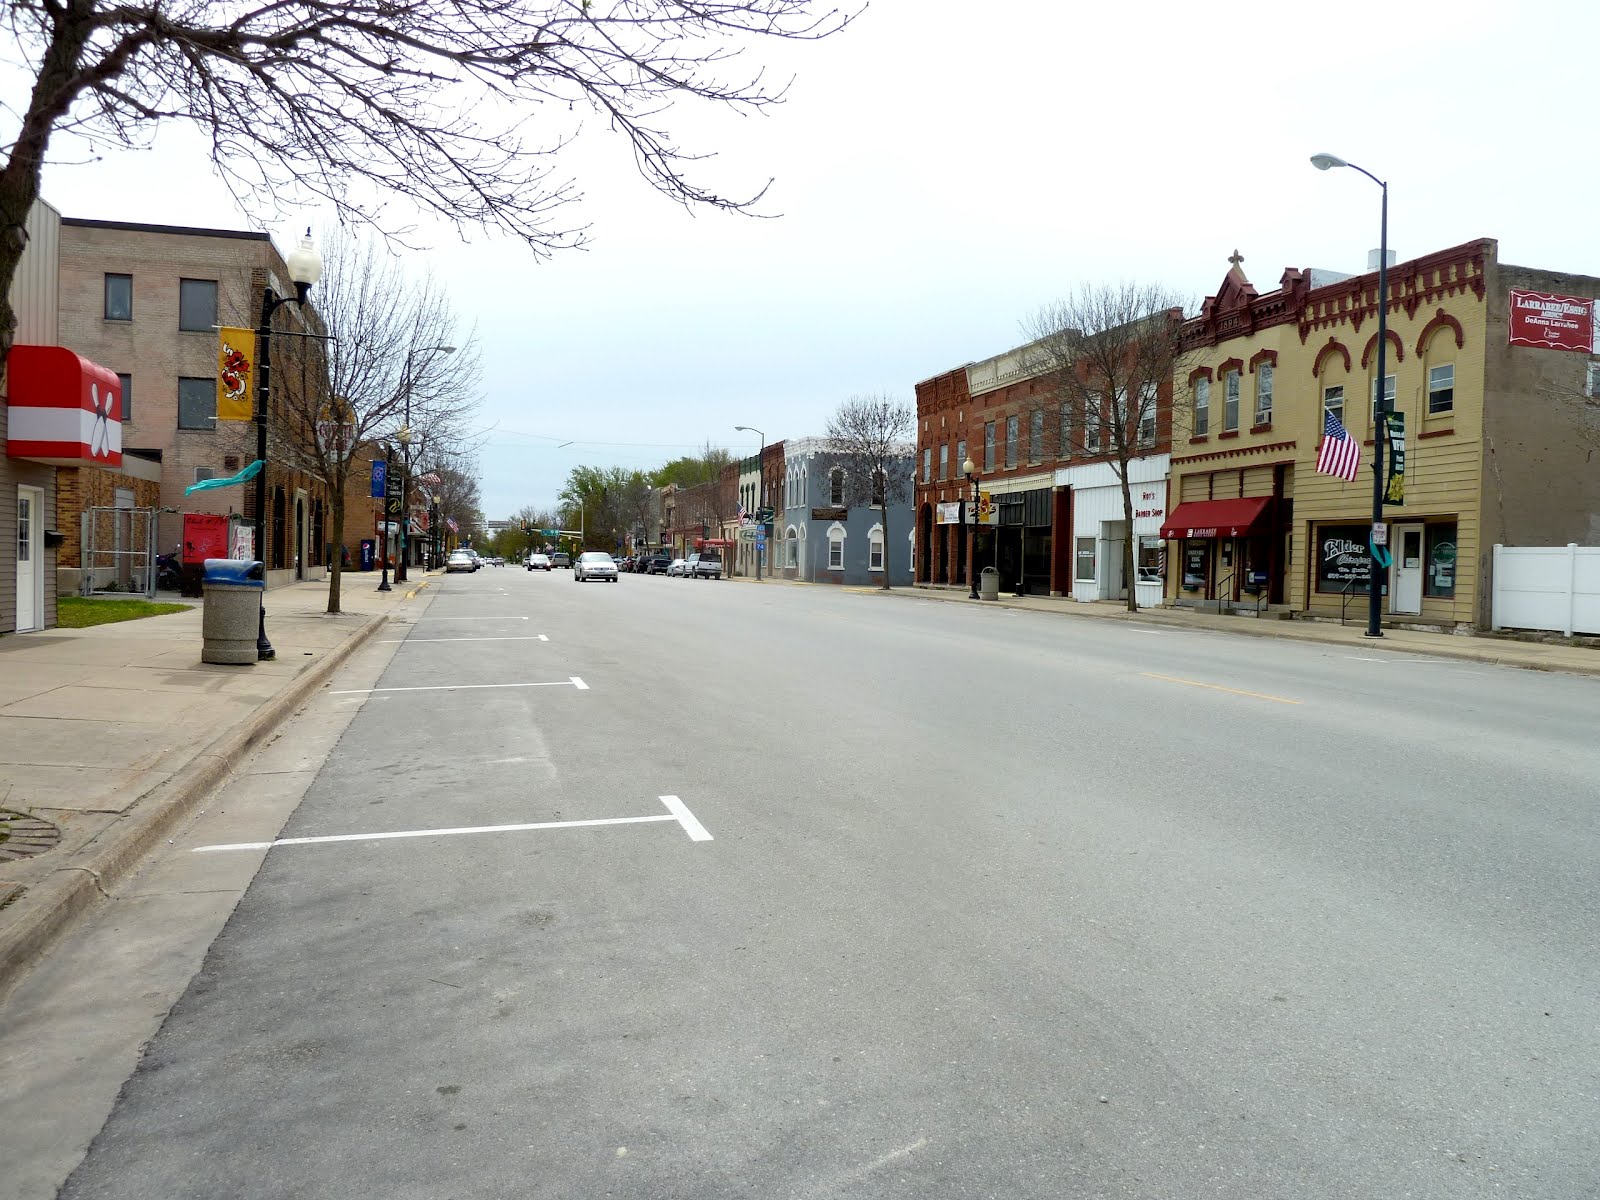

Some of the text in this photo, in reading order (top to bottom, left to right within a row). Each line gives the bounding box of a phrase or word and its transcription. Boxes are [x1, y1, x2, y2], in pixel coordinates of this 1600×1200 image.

[1525, 316, 1579, 329] DeAnna Larrabee
[1135, 508, 1163, 518] BARBER SHOP
[1323, 538, 1366, 561] Elder
